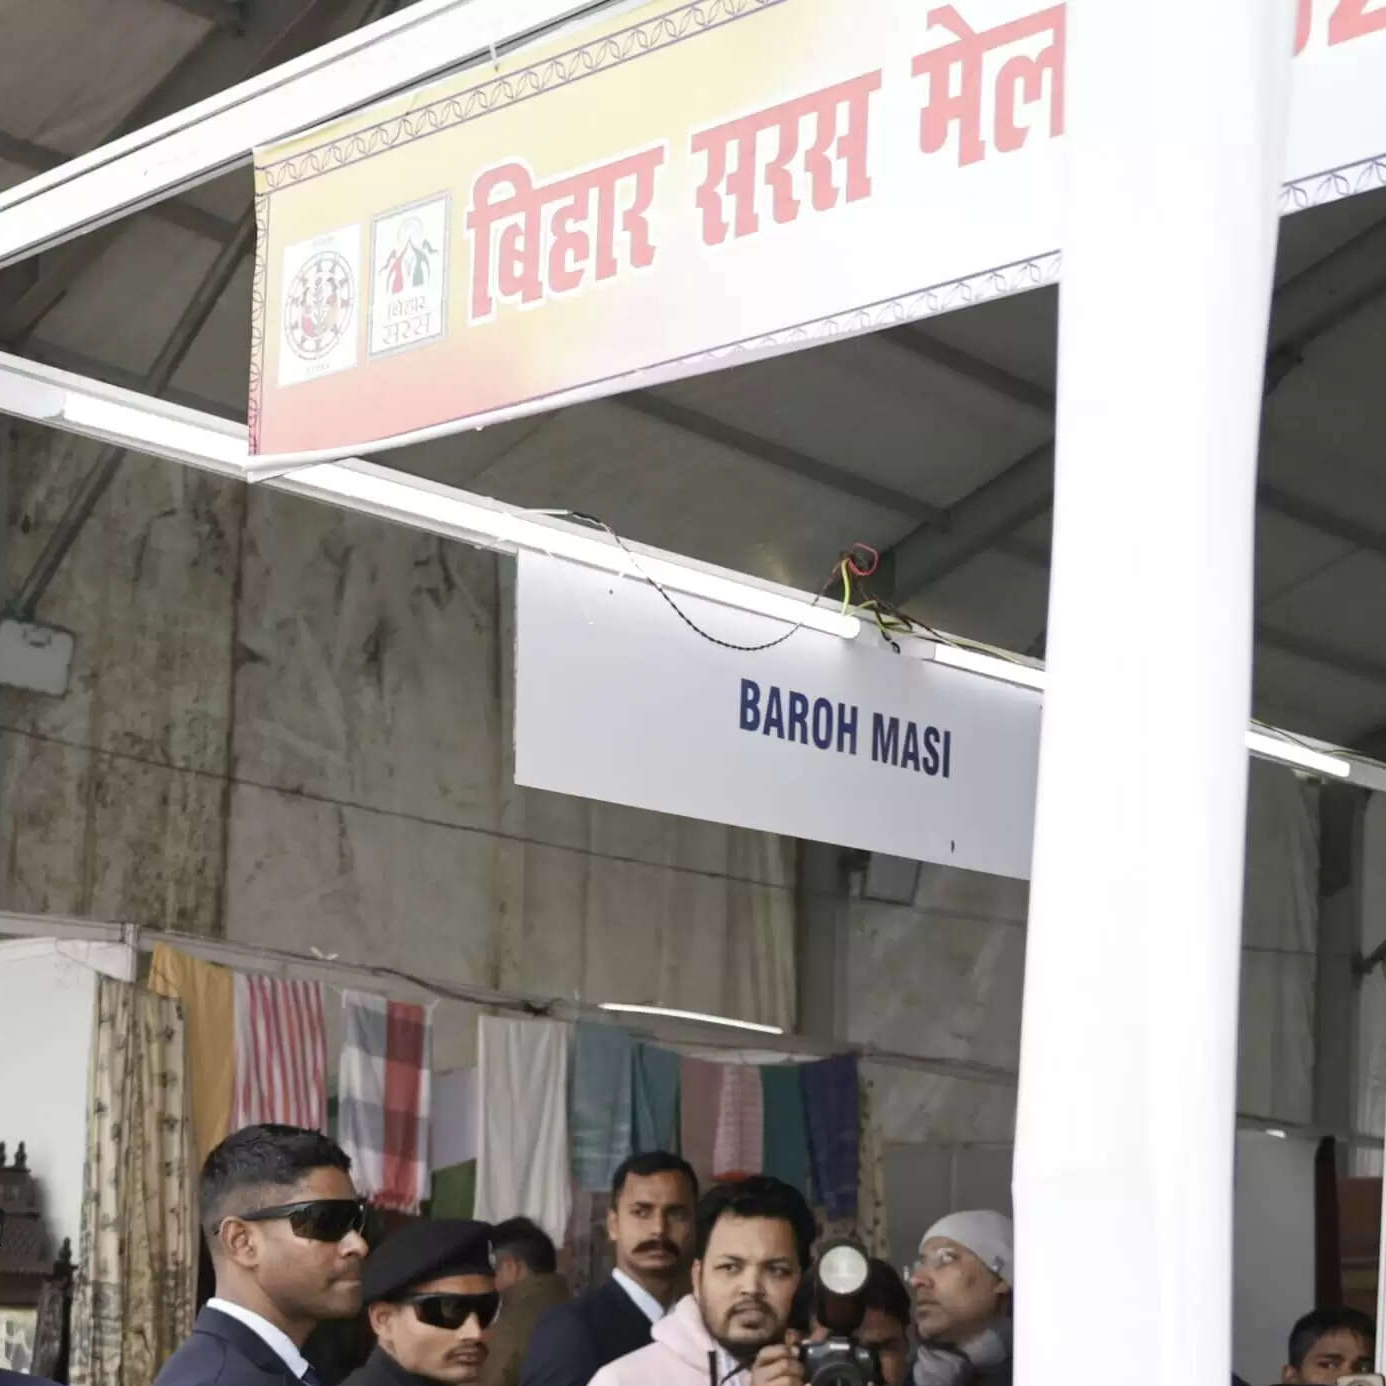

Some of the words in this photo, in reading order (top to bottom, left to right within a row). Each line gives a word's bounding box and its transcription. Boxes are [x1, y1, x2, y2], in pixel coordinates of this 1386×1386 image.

[466, 145, 665, 321] बिहार
[691, 68, 883, 246] सरस
[911, 3, 1068, 169] मेल
[739, 677, 858, 756] BAROH
[871, 712, 951, 779] MASI
